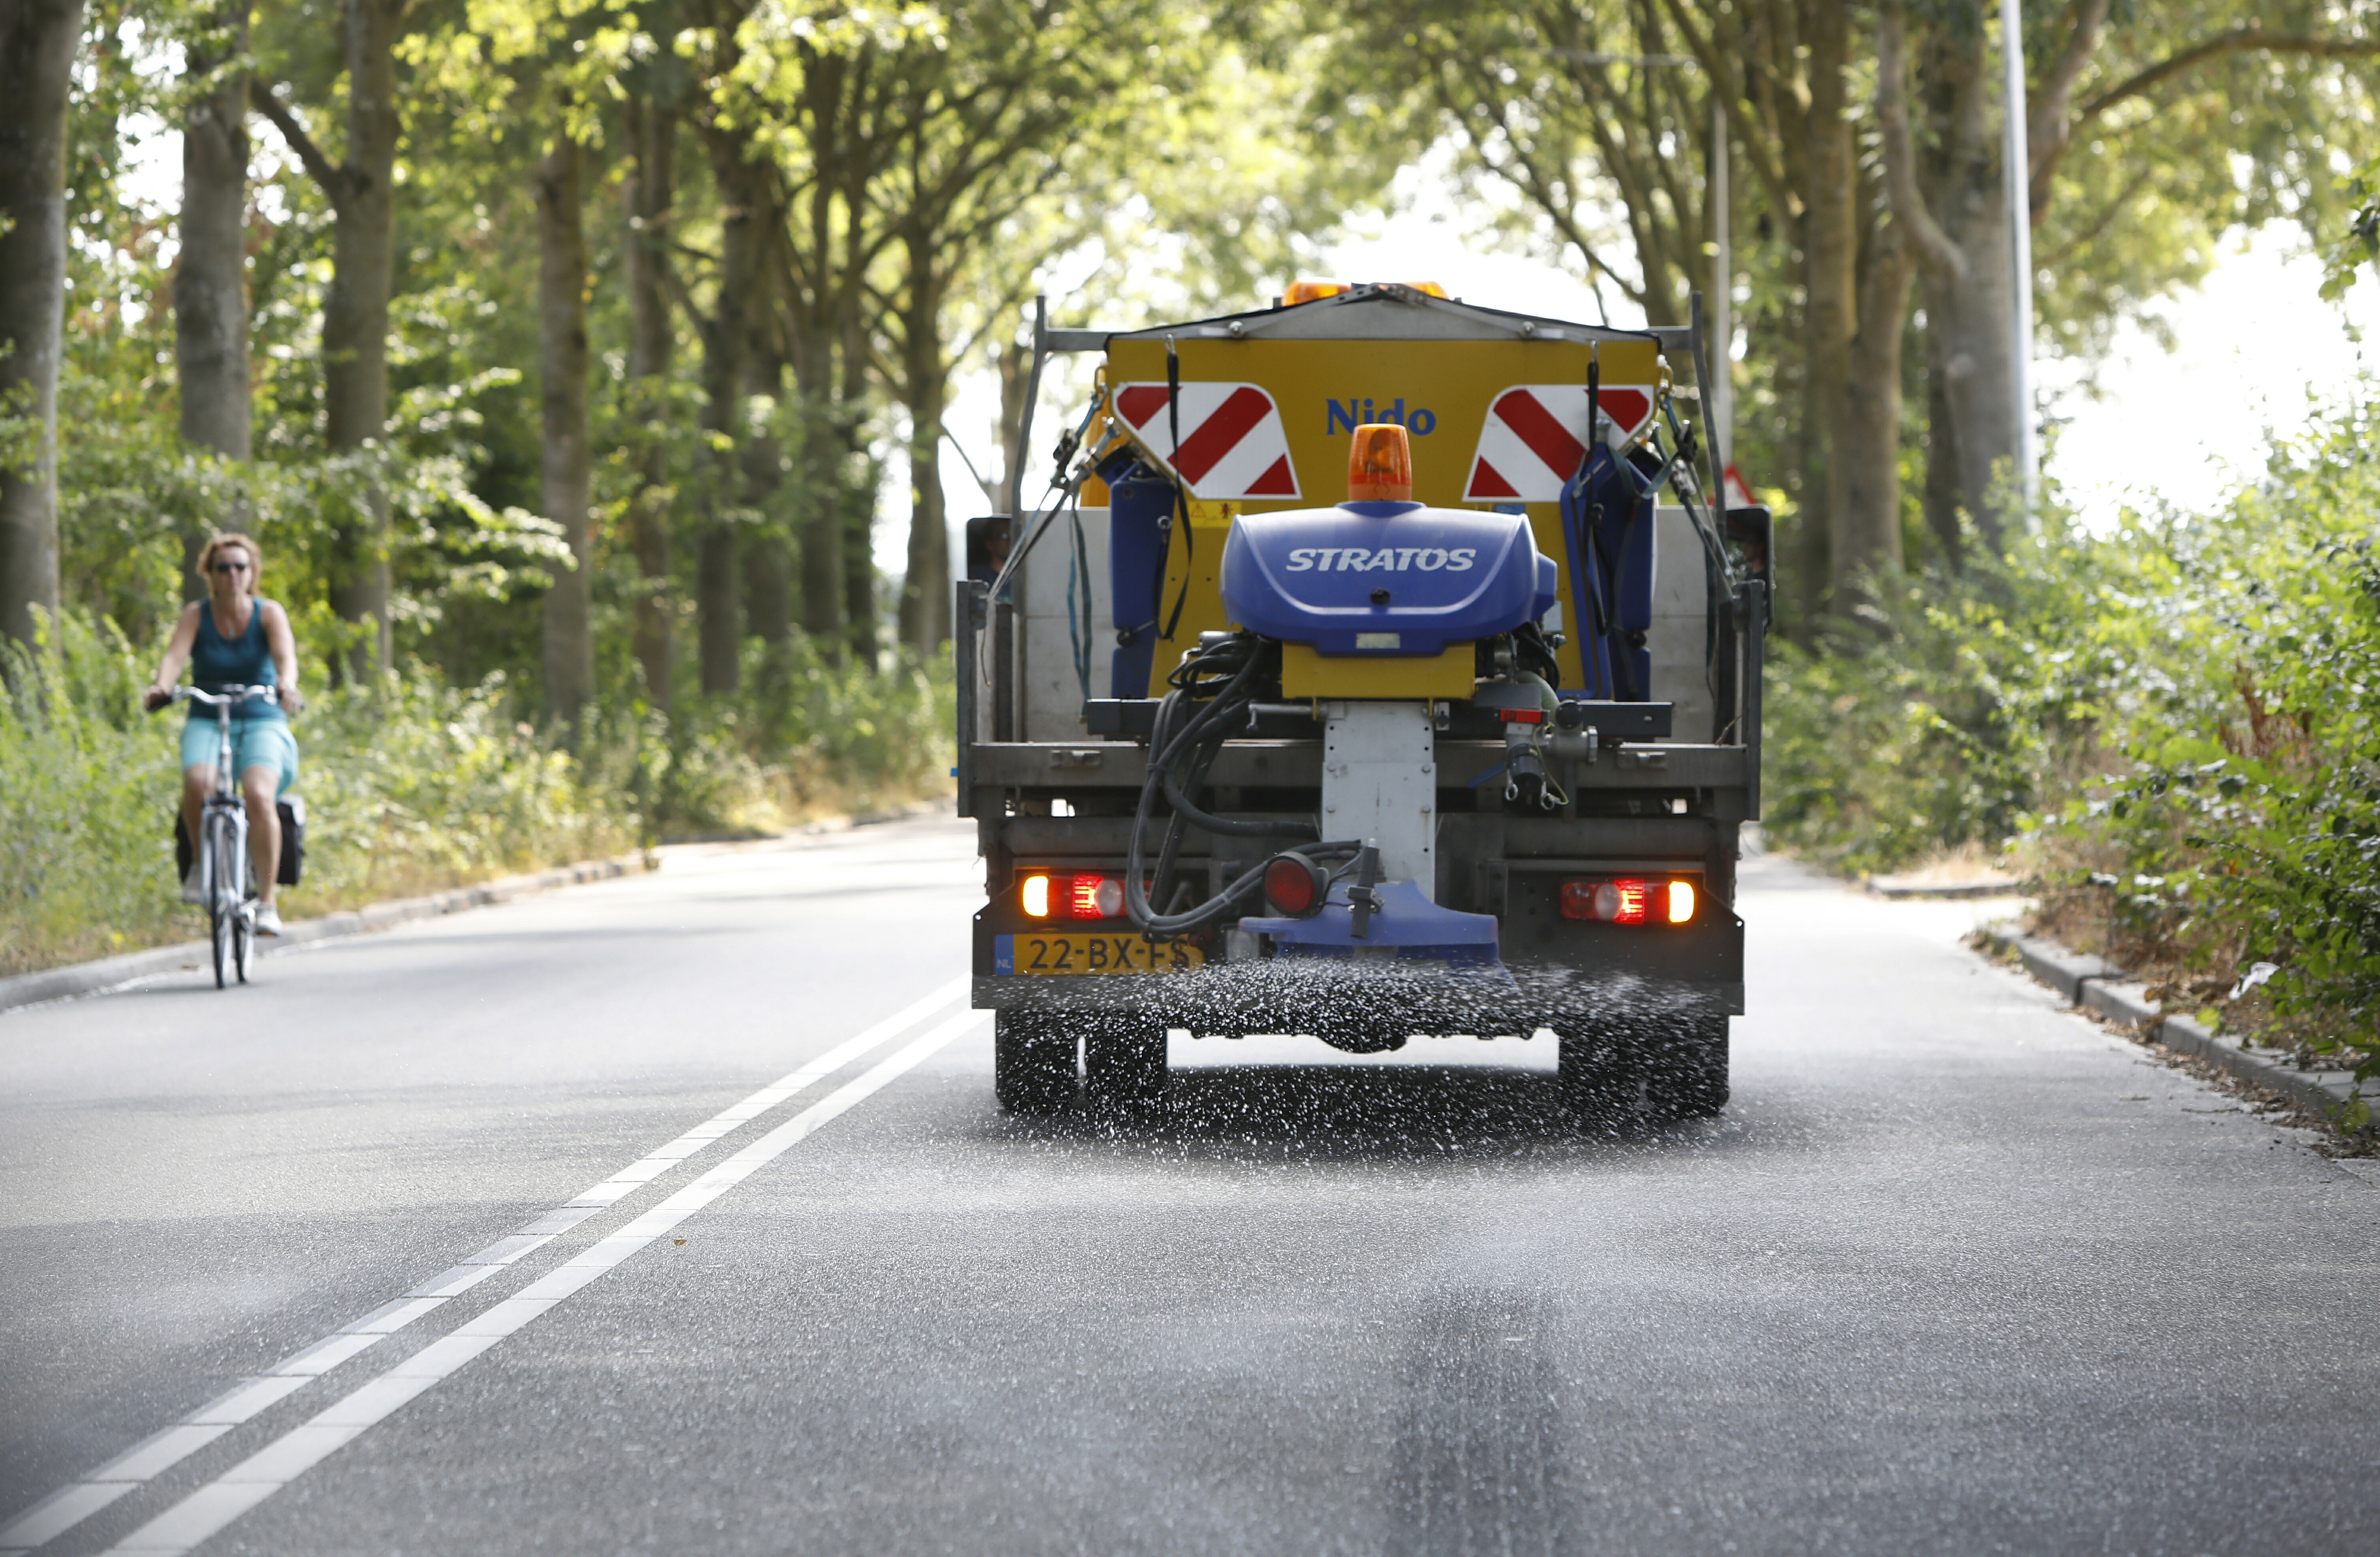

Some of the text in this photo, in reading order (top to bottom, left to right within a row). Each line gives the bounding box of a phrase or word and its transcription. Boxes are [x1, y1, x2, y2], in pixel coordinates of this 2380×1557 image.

[1326, 398, 1436, 436] Nido
[1286, 548, 1477, 572] STRATOS
[997, 959, 1012, 968] NL
